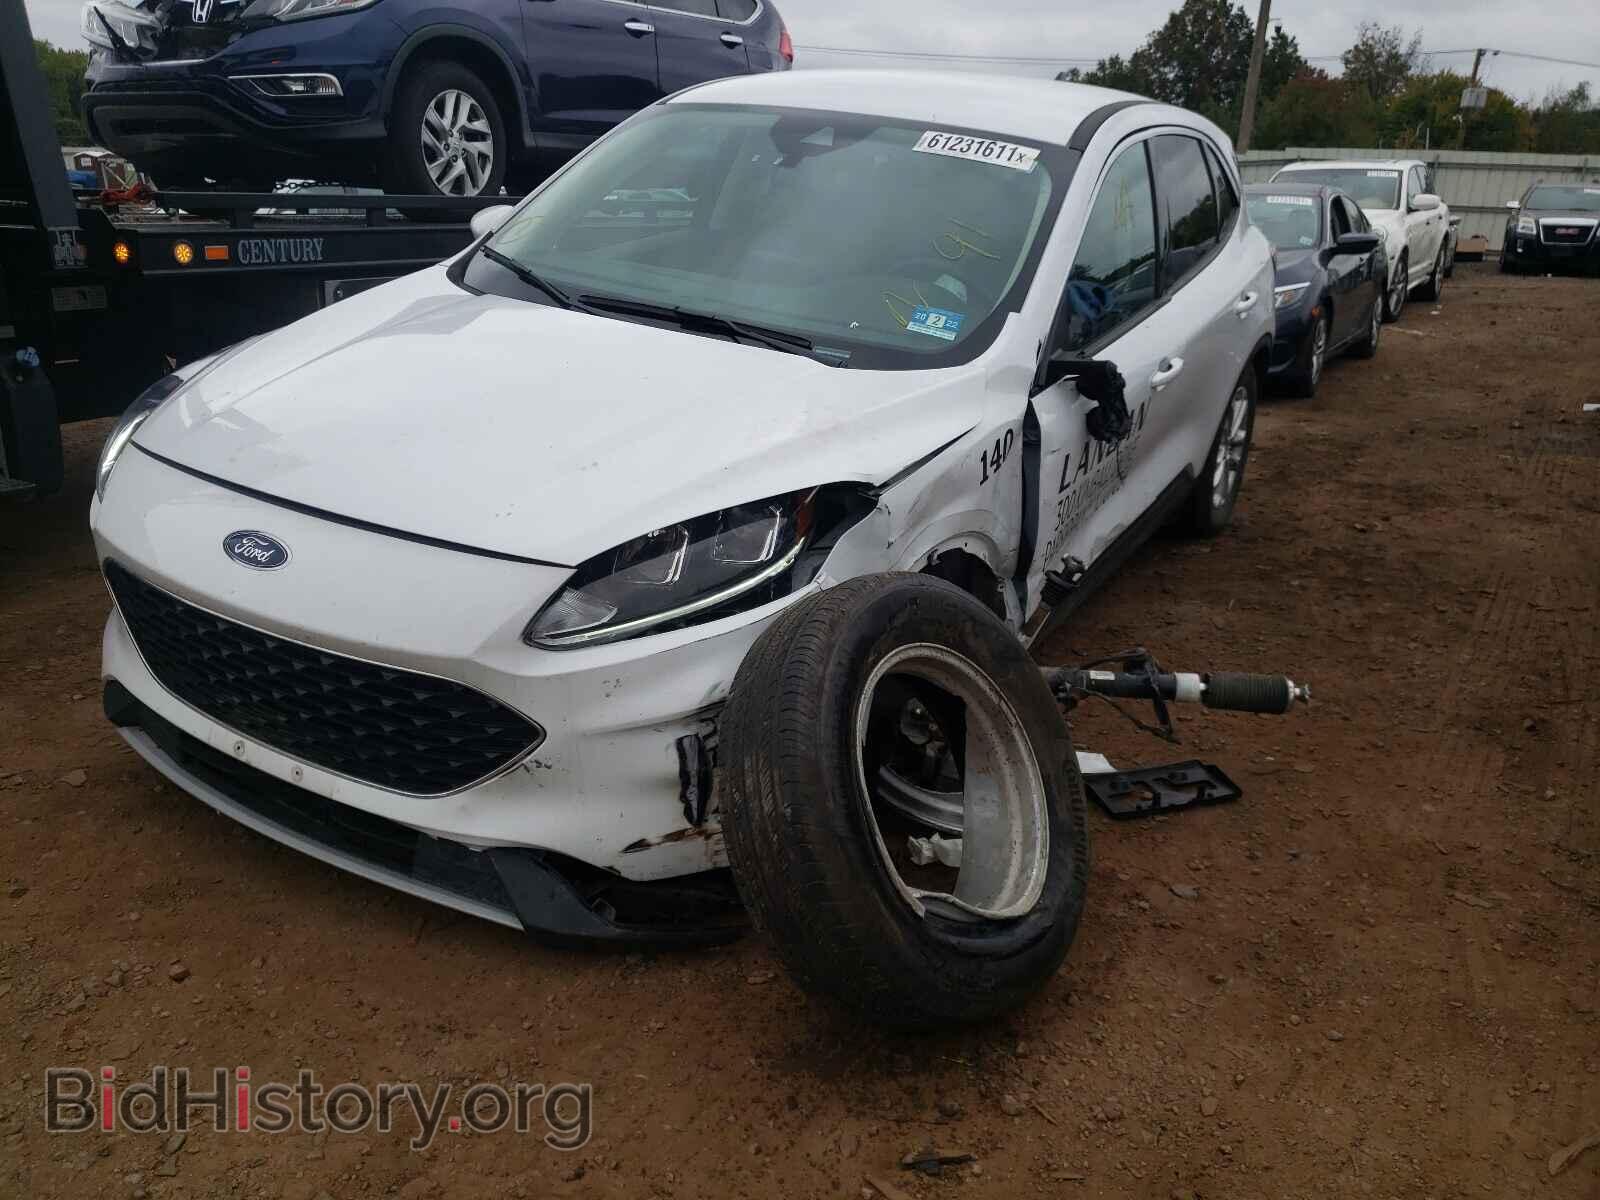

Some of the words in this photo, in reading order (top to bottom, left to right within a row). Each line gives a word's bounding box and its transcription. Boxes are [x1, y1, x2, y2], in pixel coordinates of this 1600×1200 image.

[237, 238, 324, 264] CENTURY
[931, 314, 942, 327] 2
[945, 319, 958, 329] 22
[979, 428, 1014, 486] 140
[234, 536, 276, 562] Ford
